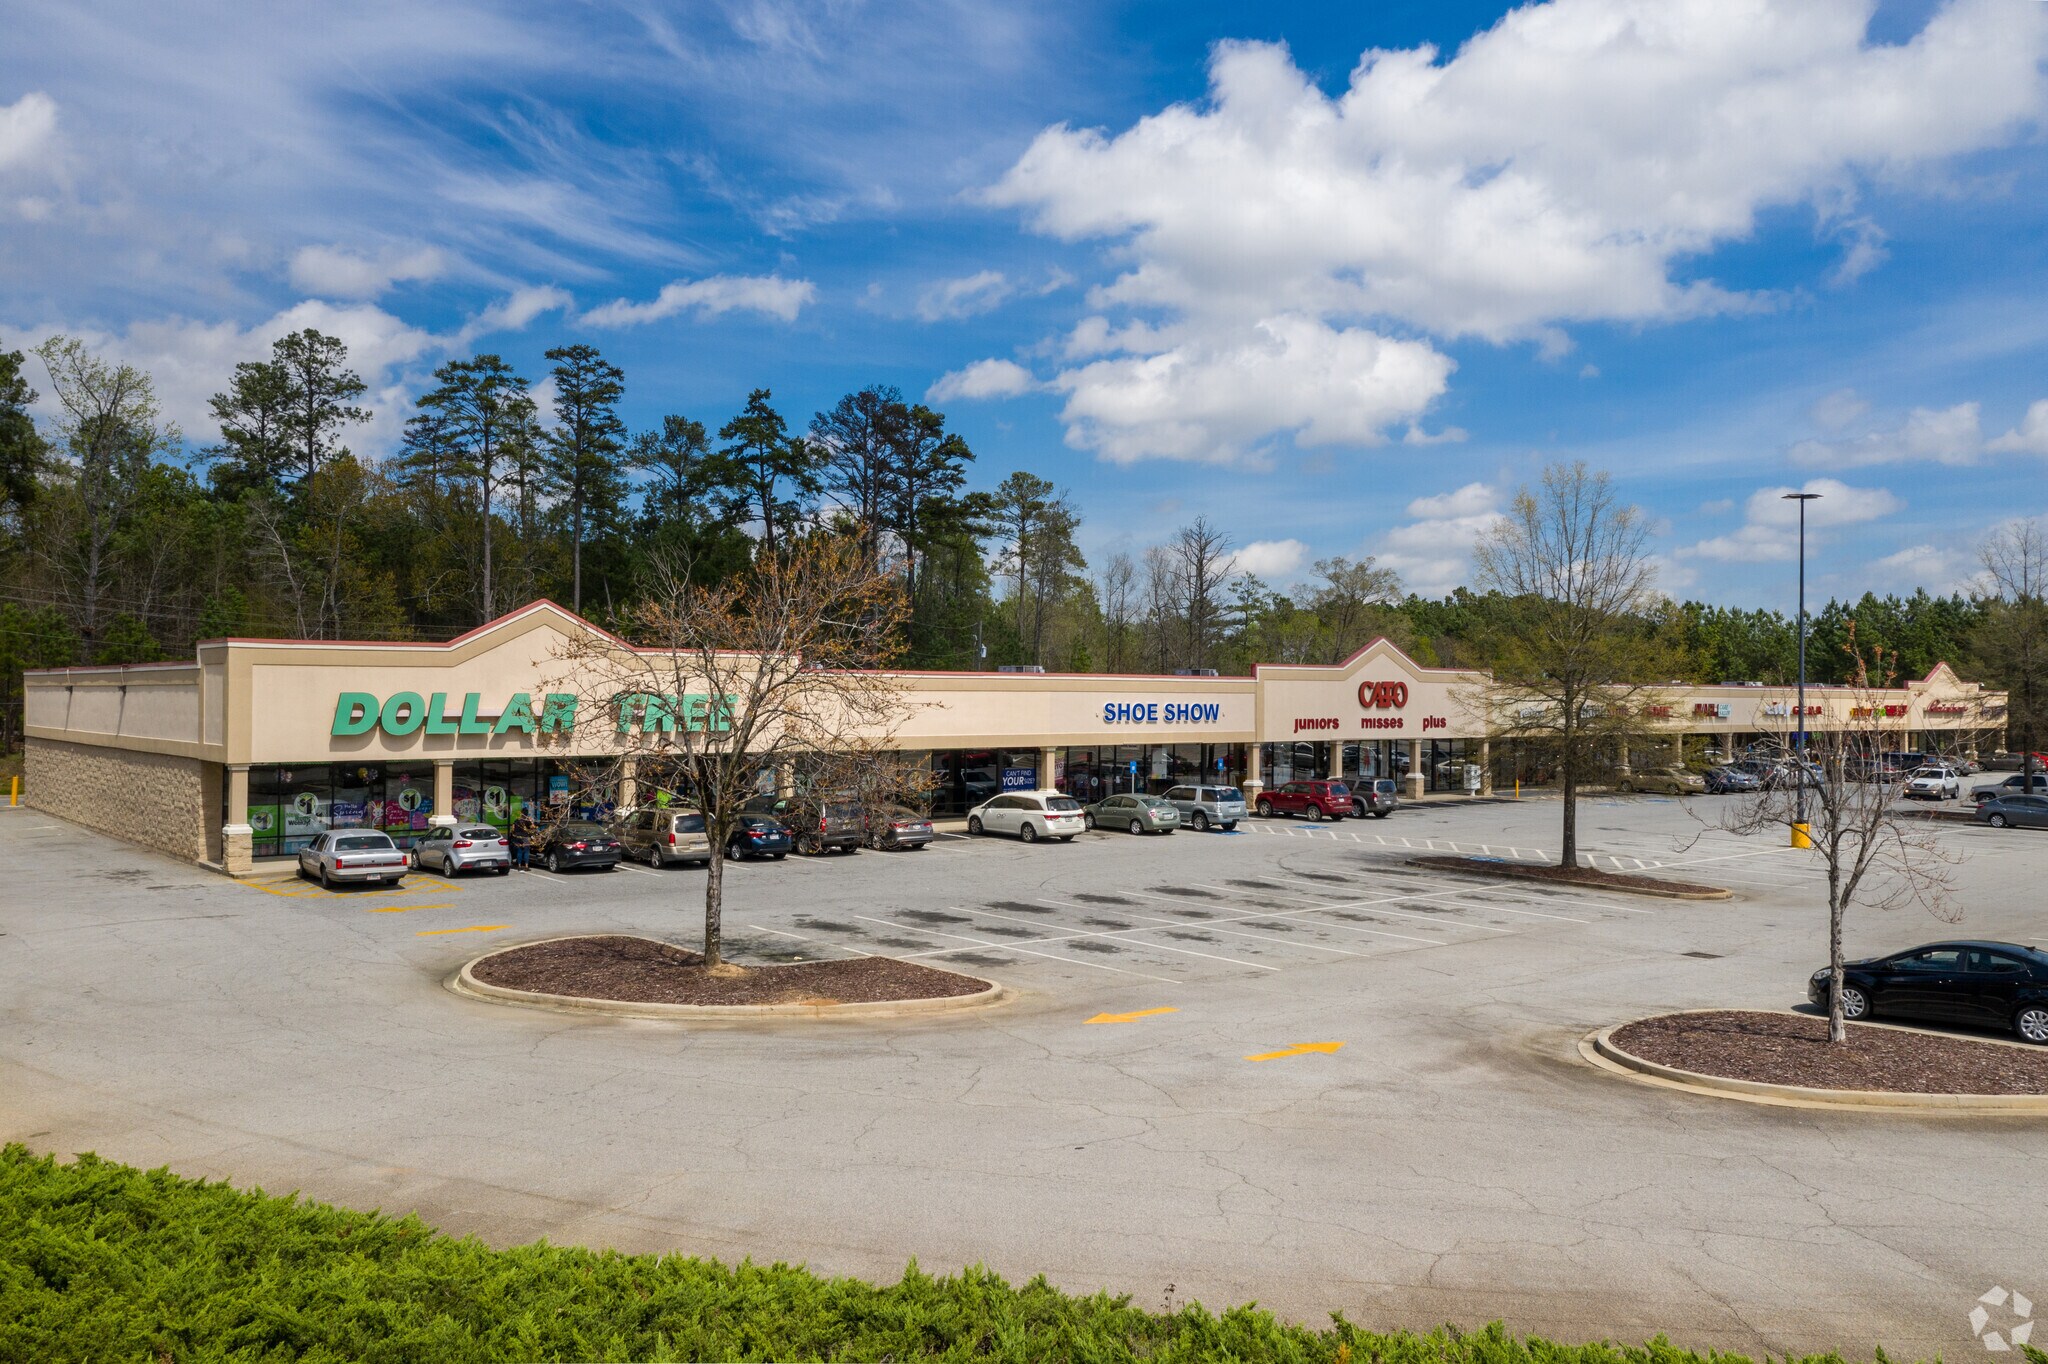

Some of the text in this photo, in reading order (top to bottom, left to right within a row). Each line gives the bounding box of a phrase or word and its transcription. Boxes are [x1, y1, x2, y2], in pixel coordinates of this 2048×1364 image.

[1359, 681, 1409, 708] CATO
[330, 691, 739, 736] DOLLAR TREE
[1103, 702, 1219, 721] SHOE SHOW
[1293, 715, 1447, 733] juniors misses plus
[1002, 776, 1025, 786] YOUR
